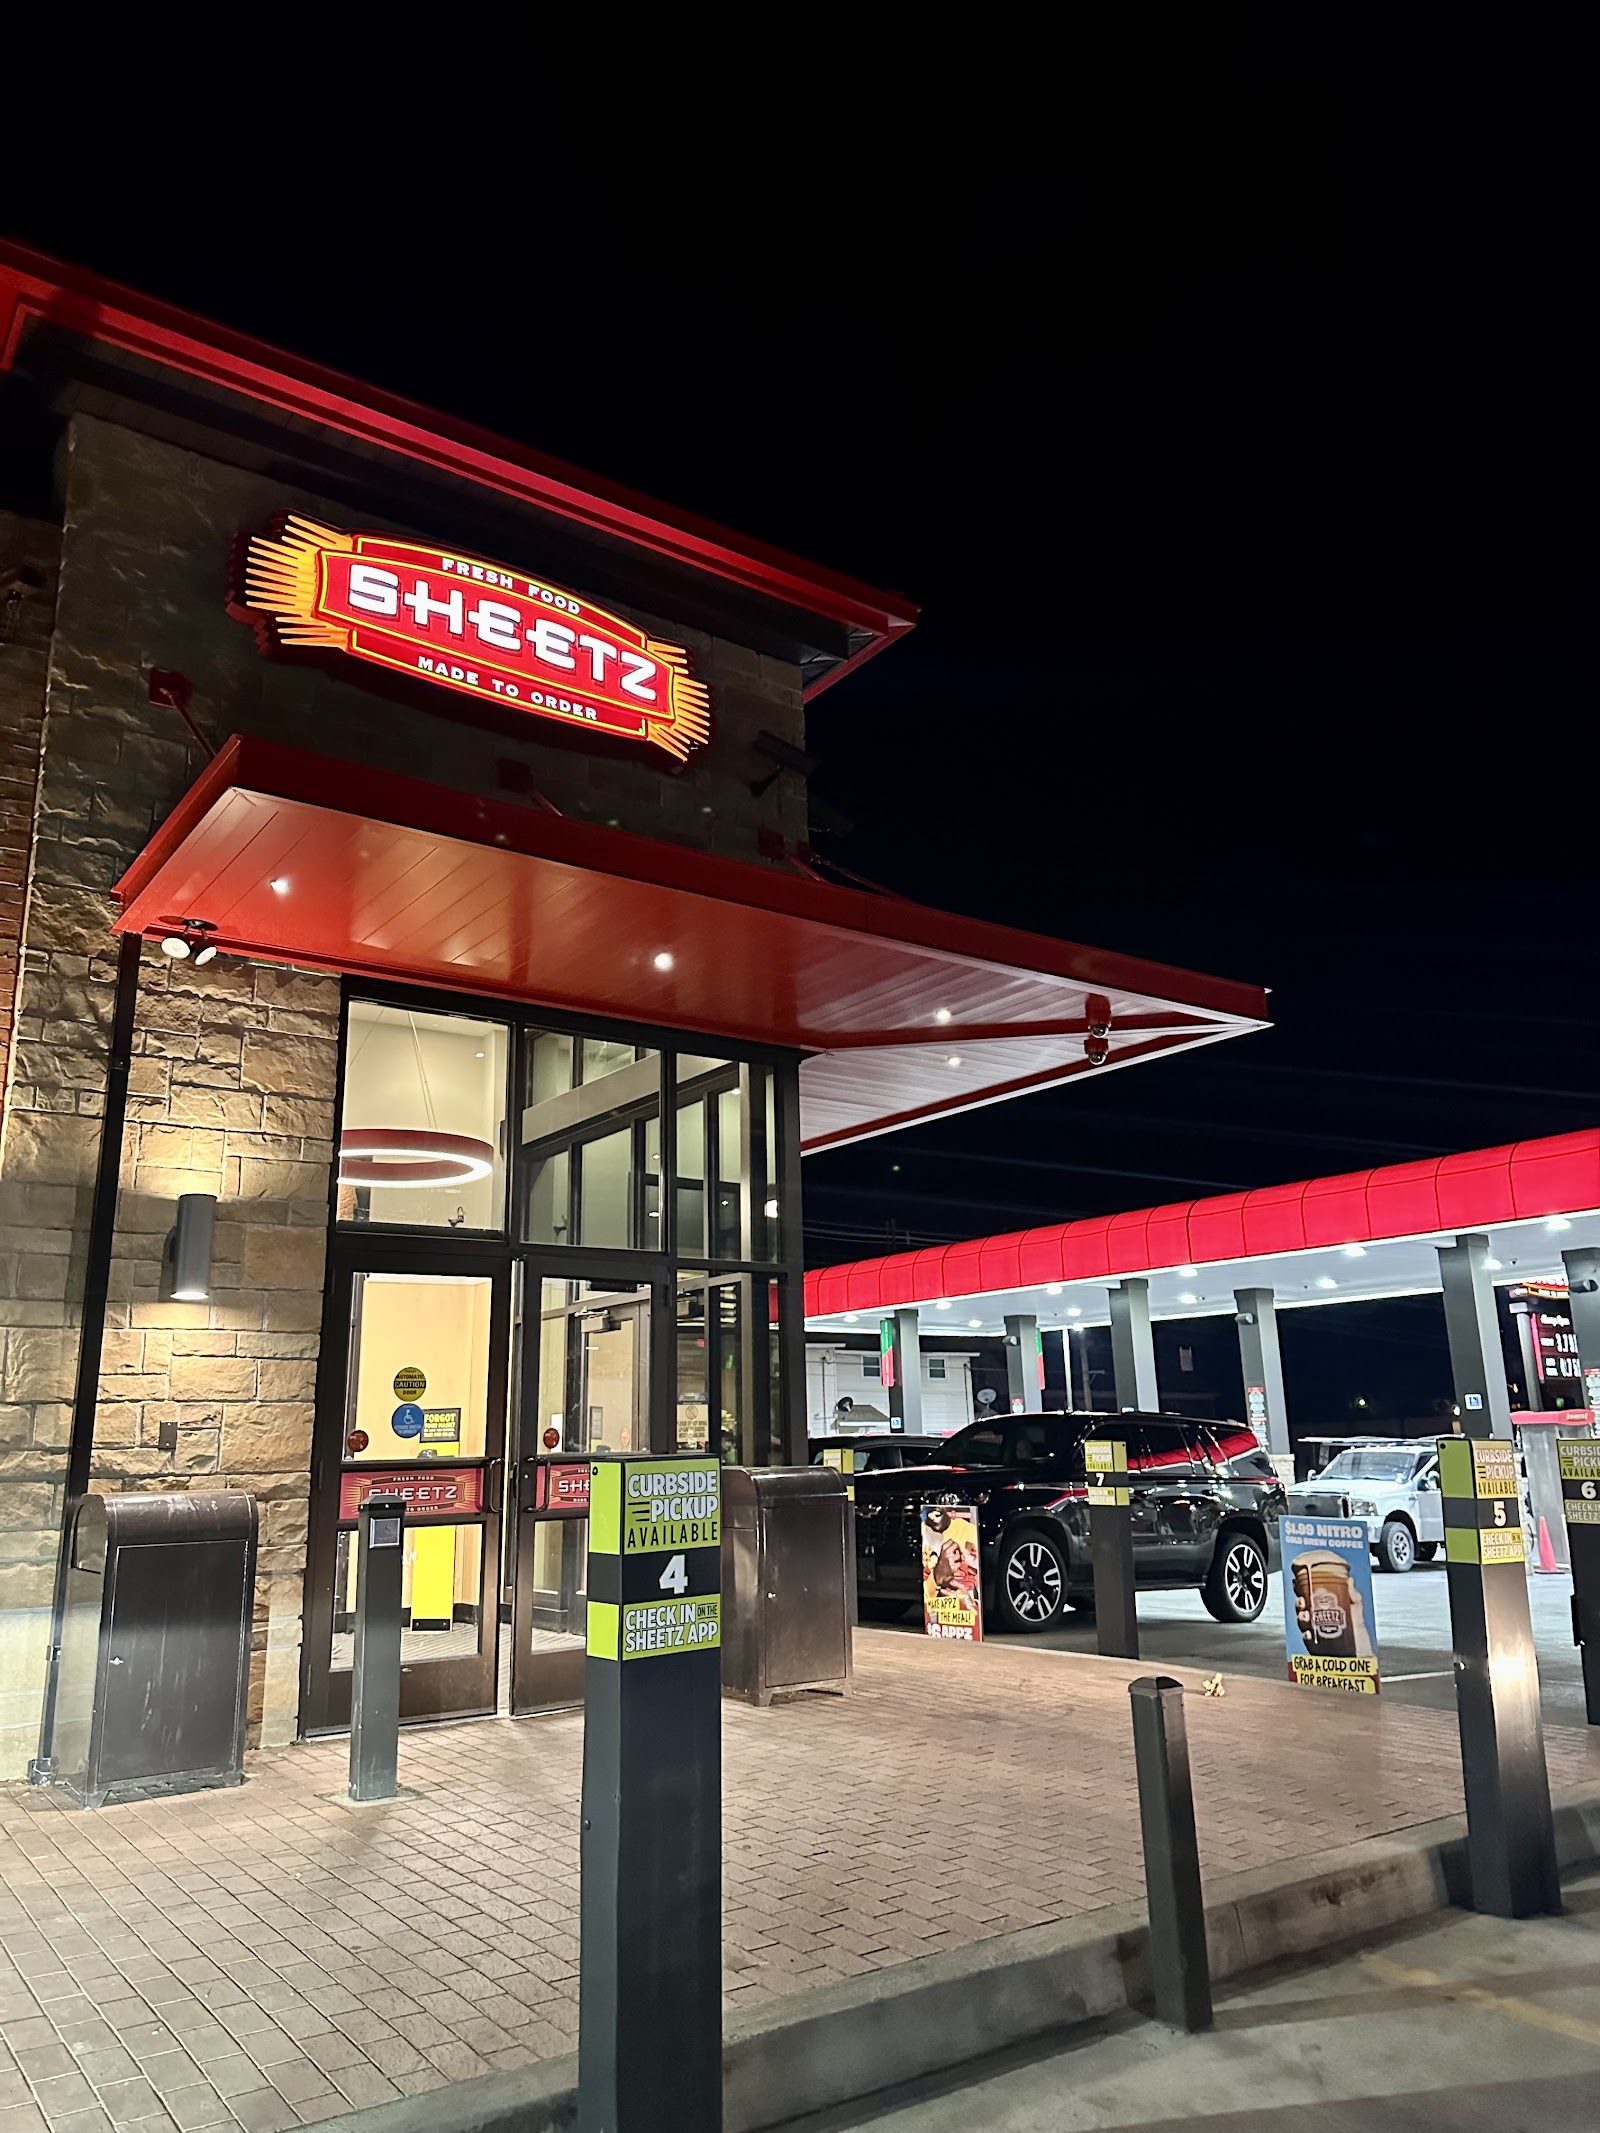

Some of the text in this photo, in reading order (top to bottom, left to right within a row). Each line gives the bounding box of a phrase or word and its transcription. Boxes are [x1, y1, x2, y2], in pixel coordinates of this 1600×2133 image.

[442, 558, 581, 615] FRESH FOOD
[349, 564, 656, 700] SHEETZ
[418, 656, 598, 721] MADE TO ORDER
[425, 1413, 456, 1423] FORGOT
[1475, 1449, 1513, 1463] CURBSIDE
[1560, 1445, 1600, 1456] CURBSID
[1573, 1456, 1600, 1467] PICK
[1095, 1472, 1104, 1487] 7
[1485, 1465, 1515, 1480] PICKUP
[1563, 1467, 1600, 1478] AVAILAB
[558, 1479, 590, 1492] SHE
[627, 1470, 717, 1498] CURBSIDE
[1478, 1481, 1516, 1495] AVAILABLE
[1581, 1480, 1597, 1499] 6
[651, 1494, 718, 1523] PICKUP
[1493, 1500, 1507, 1527] 5
[1566, 1502, 1593, 1511] CHECK
[1567, 1511, 1598, 1520] SHEETZ
[627, 1521, 718, 1548] AVAILABLE
[1284, 1520, 1363, 1539] $1.99 NITRO
[1285, 1536, 1364, 1549] COLD BREW COFFEE
[1482, 1533, 1504, 1546] CHECK
[1504, 1532, 1513, 1544] IN
[1483, 1544, 1522, 1559] SHEETZ APP
[658, 1554, 689, 1595] 4
[941, 1597, 957, 1610] APPZ
[625, 1603, 718, 1631] CHECK IN ON THE
[940, 1611, 971, 1624] THE MEAL!
[625, 1621, 718, 1653] SHEETZ APP
[1294, 1656, 1371, 1673] GRAB A COLD ONE
[1300, 1673, 1365, 1692] FOR BREAKFAST
